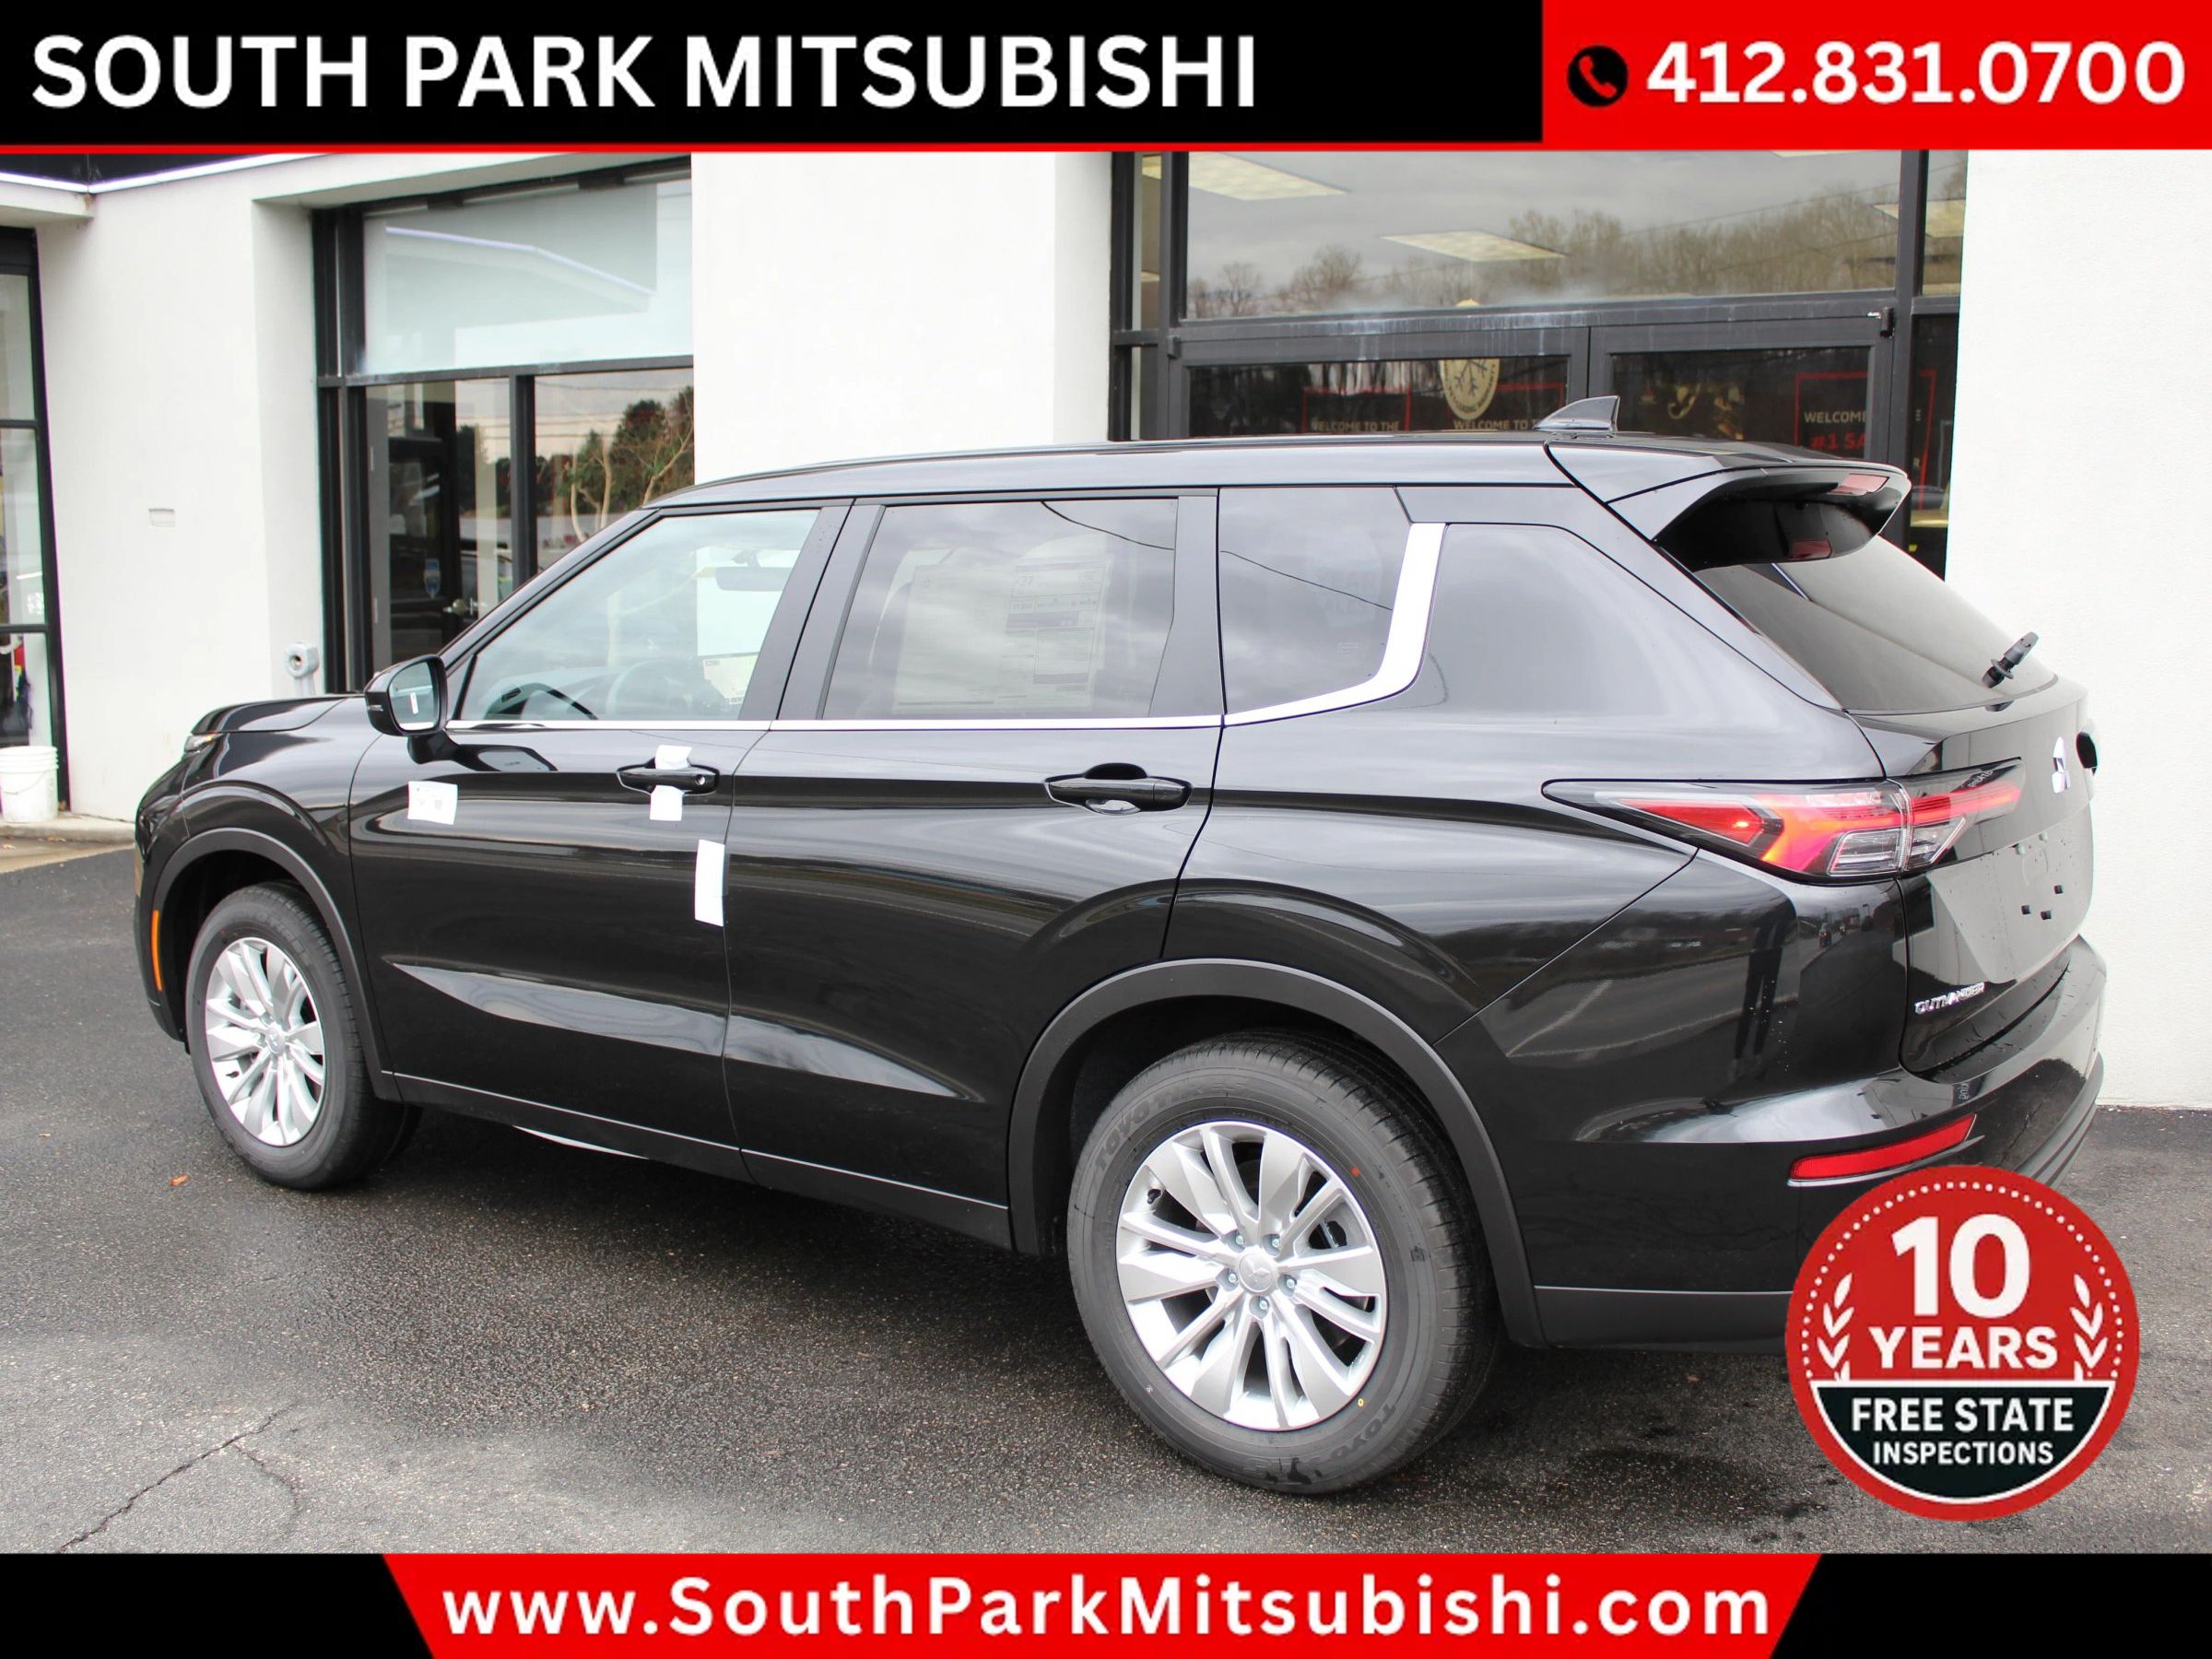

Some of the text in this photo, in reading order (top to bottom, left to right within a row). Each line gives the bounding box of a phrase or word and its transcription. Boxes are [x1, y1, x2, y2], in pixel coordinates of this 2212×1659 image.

[1364, 421, 1379, 432] TO
[1513, 419, 1529, 430] TO
[1811, 433, 1838, 450] #1
[1914, 981, 1985, 1014] OUTLANDER
